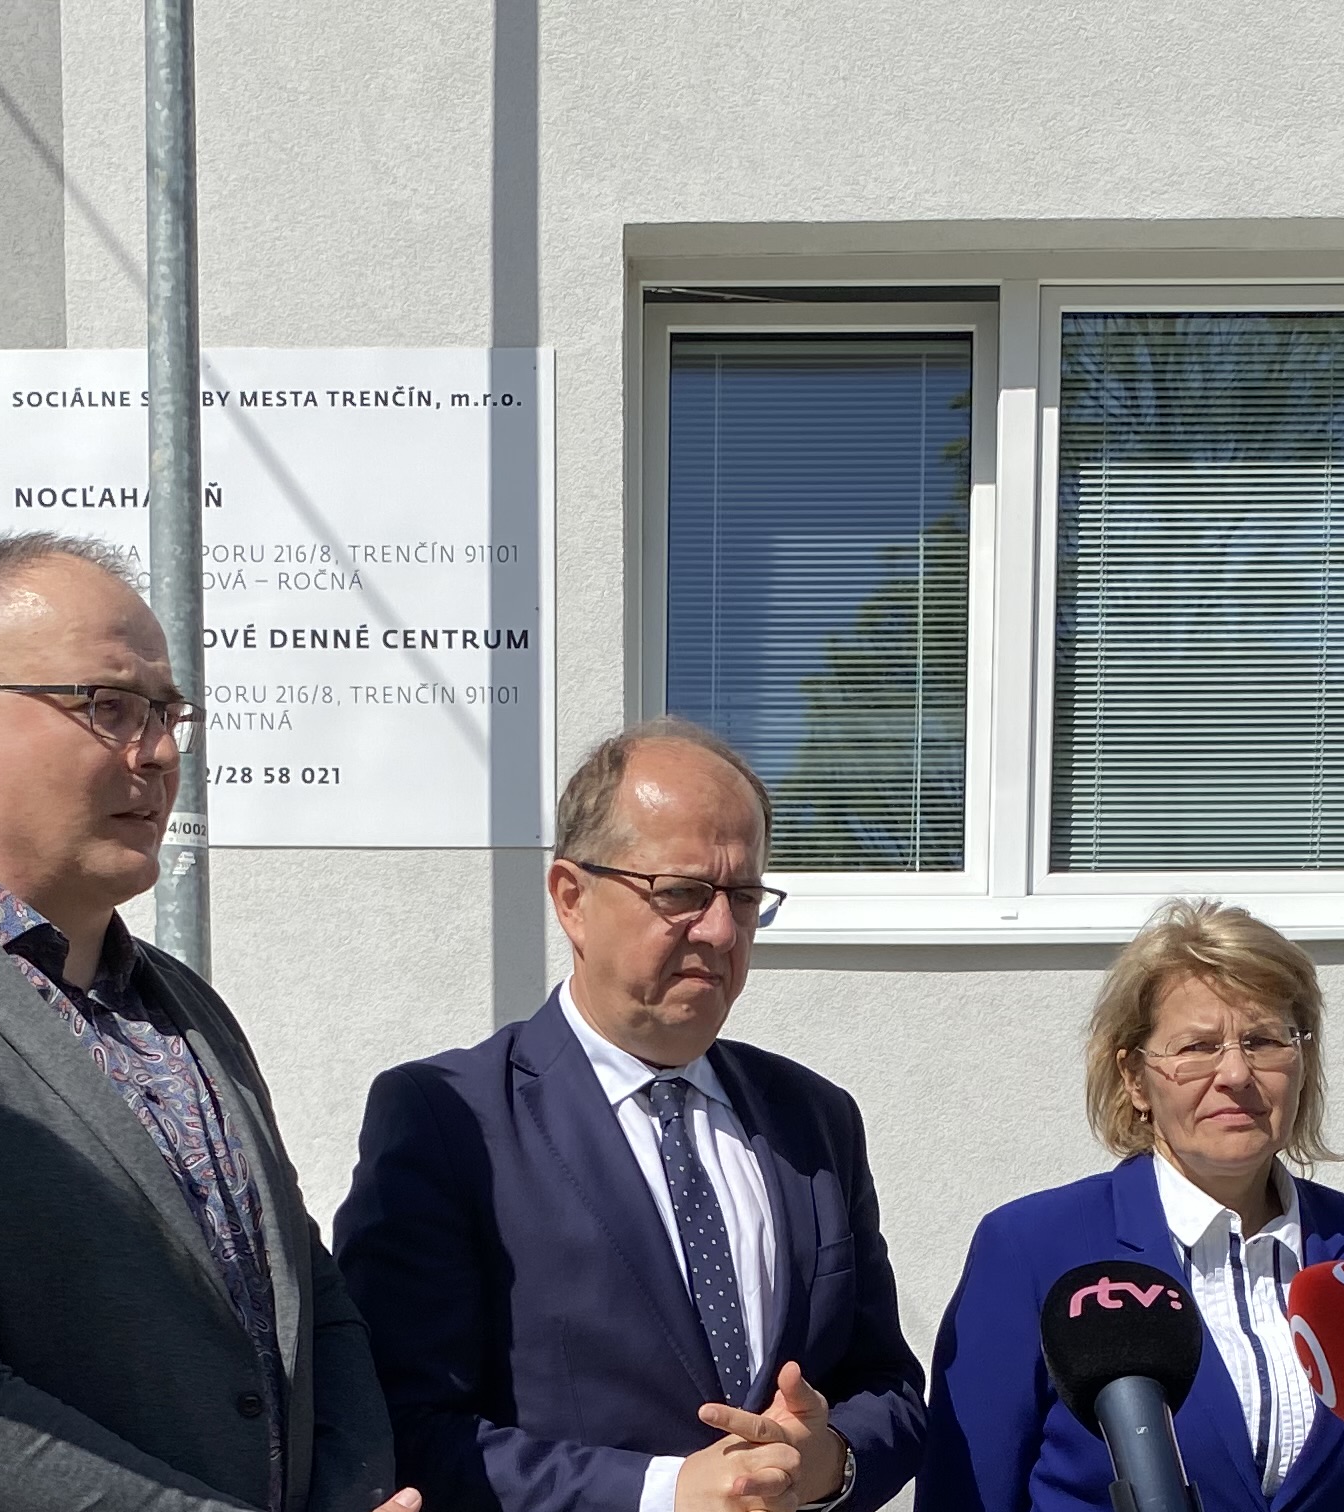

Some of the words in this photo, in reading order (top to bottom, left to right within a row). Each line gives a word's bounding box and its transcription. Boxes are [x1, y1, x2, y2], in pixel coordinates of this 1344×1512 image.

[12, 387, 131, 408] SOCIÁLNE
[141, 390, 230, 408] SBY
[240, 390, 318, 408] MESTA
[326, 386, 441, 410] TRENČÍN,
[451, 393, 522, 407] m.r.o.
[15, 482, 223, 508] NOCĽAHŇ
[202, 544, 264, 564] PORU
[274, 544, 339, 566] 216/8,
[348, 541, 454, 563] TRENČÍN
[465, 544, 518, 563] 91101
[278, 568, 363, 590] ROČNÁ
[270, 624, 369, 649] DENNÉ
[382, 628, 529, 650] CENTRUM
[205, 685, 266, 703] PORU
[276, 685, 341, 706] 216/8,
[349, 682, 455, 704] TRENČÍN
[466, 685, 518, 704] 91101
[263, 766, 291, 785] 58
[301, 766, 340, 785] 021
